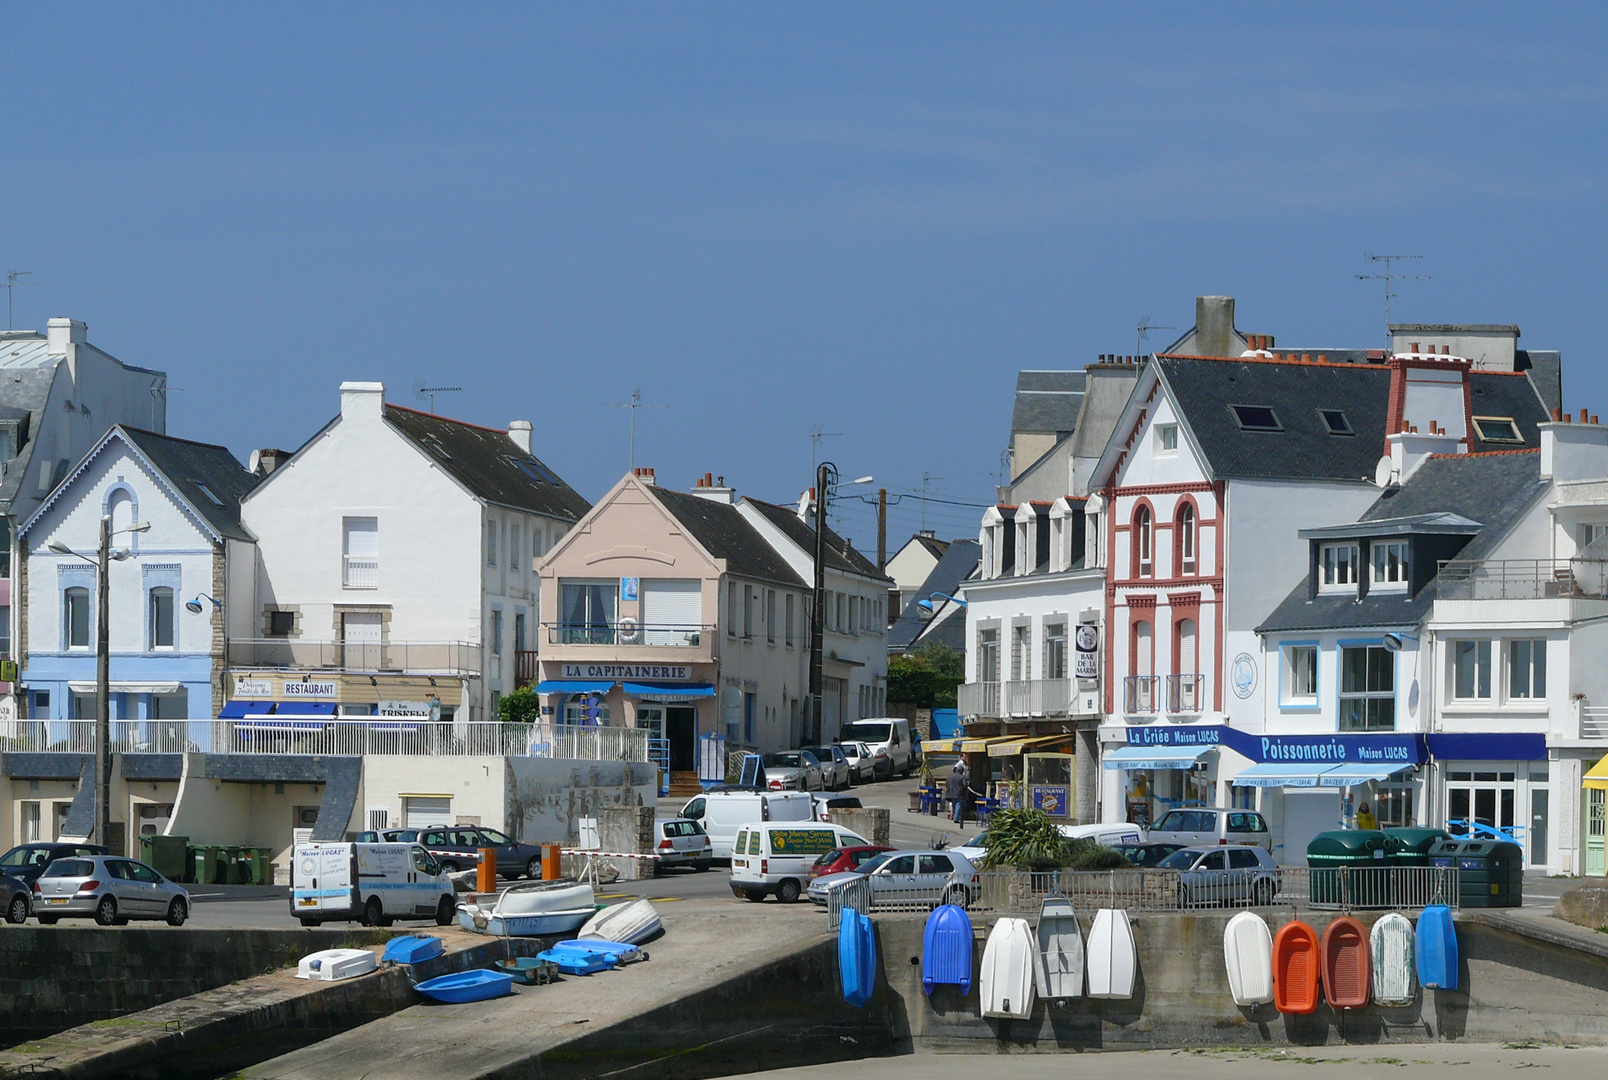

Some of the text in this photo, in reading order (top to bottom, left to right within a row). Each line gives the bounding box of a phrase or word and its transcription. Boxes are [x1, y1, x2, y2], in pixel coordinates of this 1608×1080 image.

[566, 665, 686, 678] LA CAPITAINERIE
[285, 684, 334, 694] RESTAURANT
[1129, 728, 1219, 744] La Criée Maison LUCAS
[1261, 737, 1409, 760] Poissonnerie Maison LUCAS
